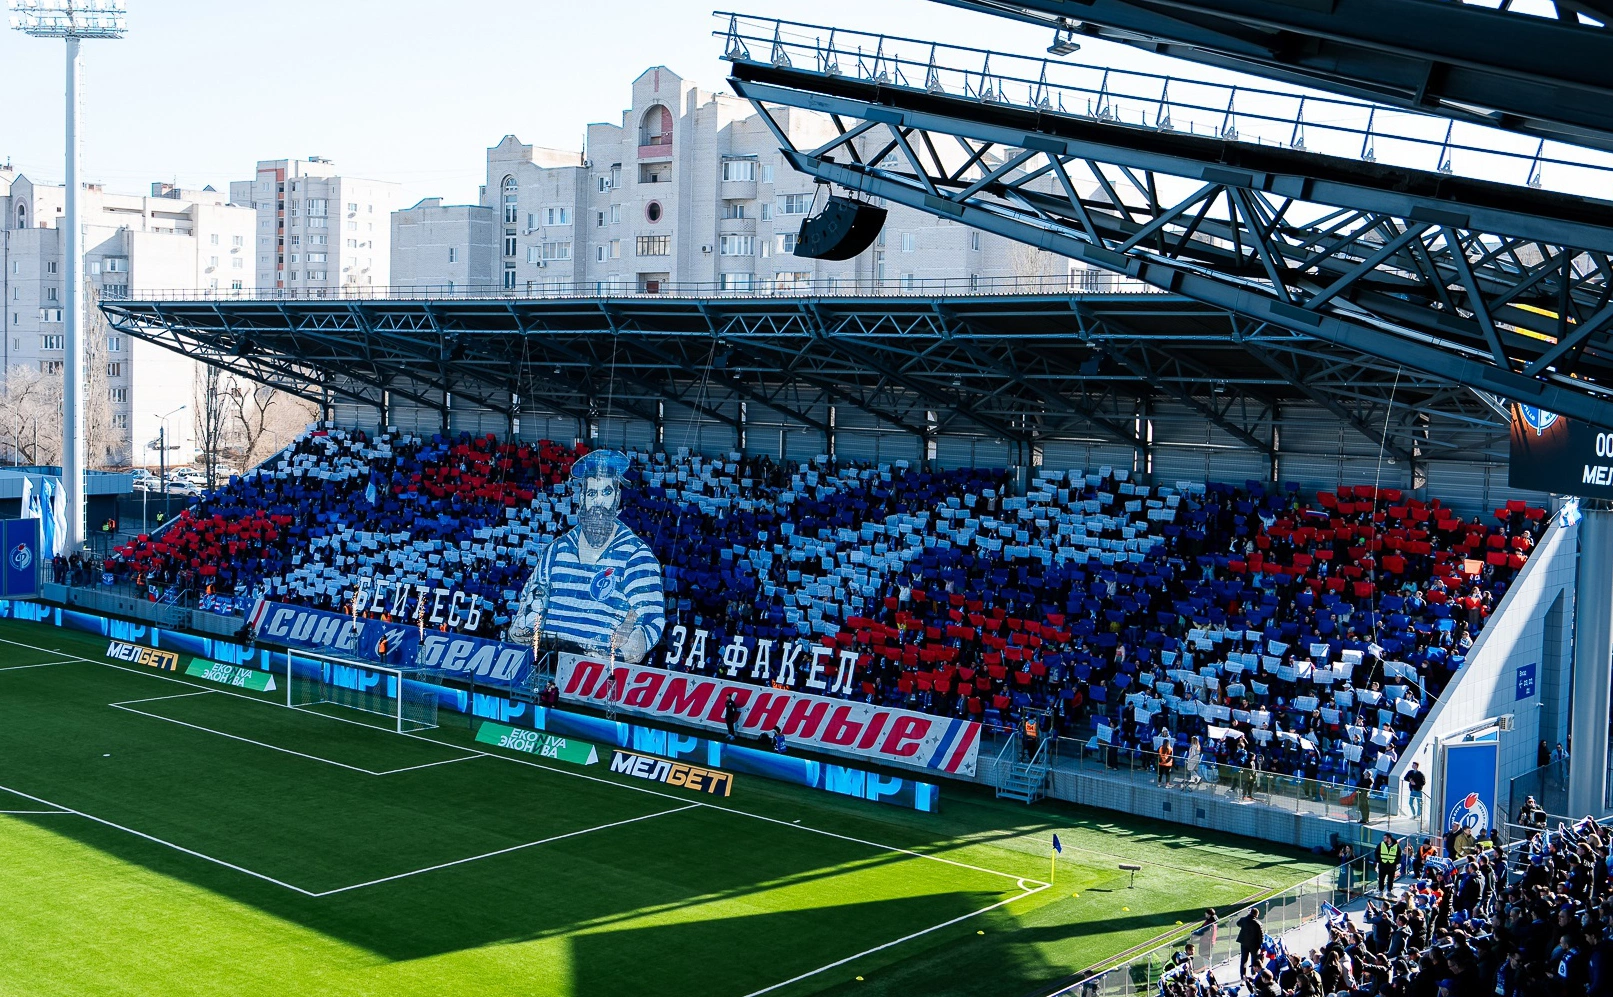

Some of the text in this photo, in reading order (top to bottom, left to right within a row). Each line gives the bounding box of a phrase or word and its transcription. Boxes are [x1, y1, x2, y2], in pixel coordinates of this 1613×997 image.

[106, 641, 178, 671] МЕЛБЕТ
[665, 625, 859, 695] ЗА ФАКЕЛ
[609, 751, 733, 797] МЕЛБЕТ
